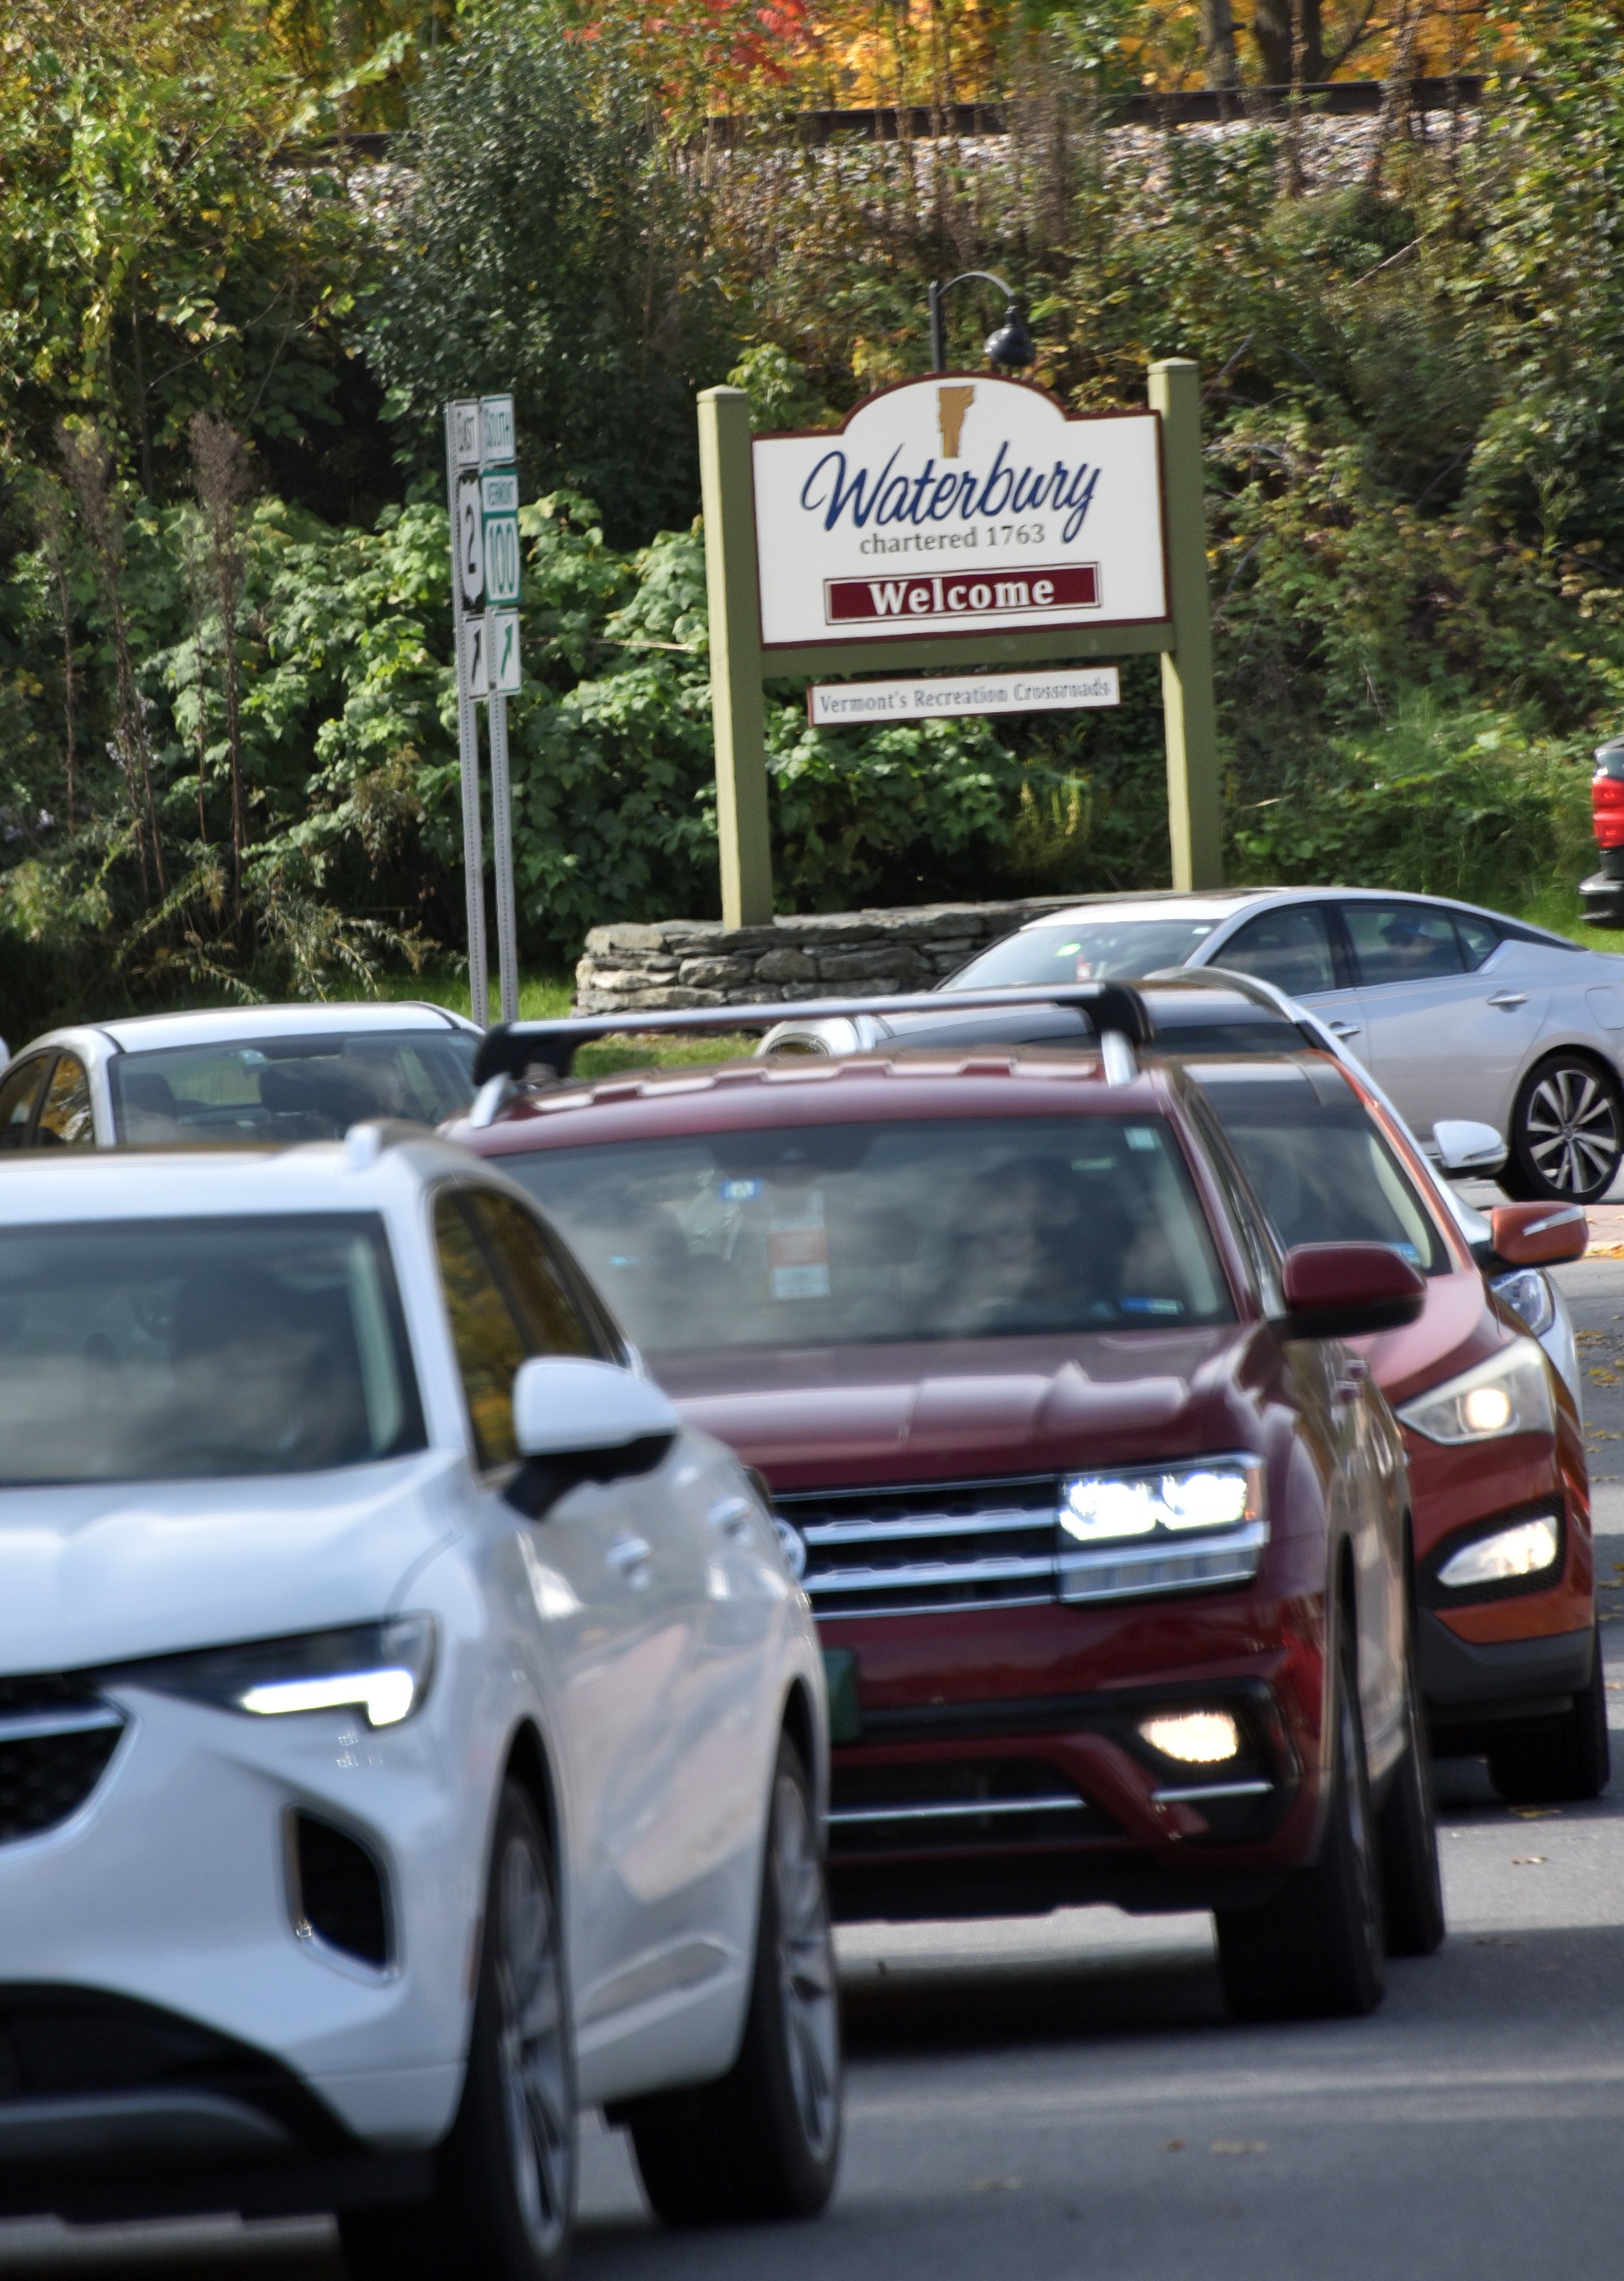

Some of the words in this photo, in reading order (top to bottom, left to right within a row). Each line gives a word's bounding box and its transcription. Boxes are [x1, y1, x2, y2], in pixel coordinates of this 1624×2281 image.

[483, 408, 513, 447] SOUTH
[800, 441, 1100, 543] Waterbury
[464, 503, 476, 574] 2
[489, 522, 515, 594] 100
[859, 526, 978, 555] chartered
[987, 524, 1045, 547] 1763
[867, 576, 1055, 616] Welcome
[820, 691, 907, 713] Vermont's
[914, 685, 1008, 707] Recreation
[1014, 678, 1111, 701] Crossroads
